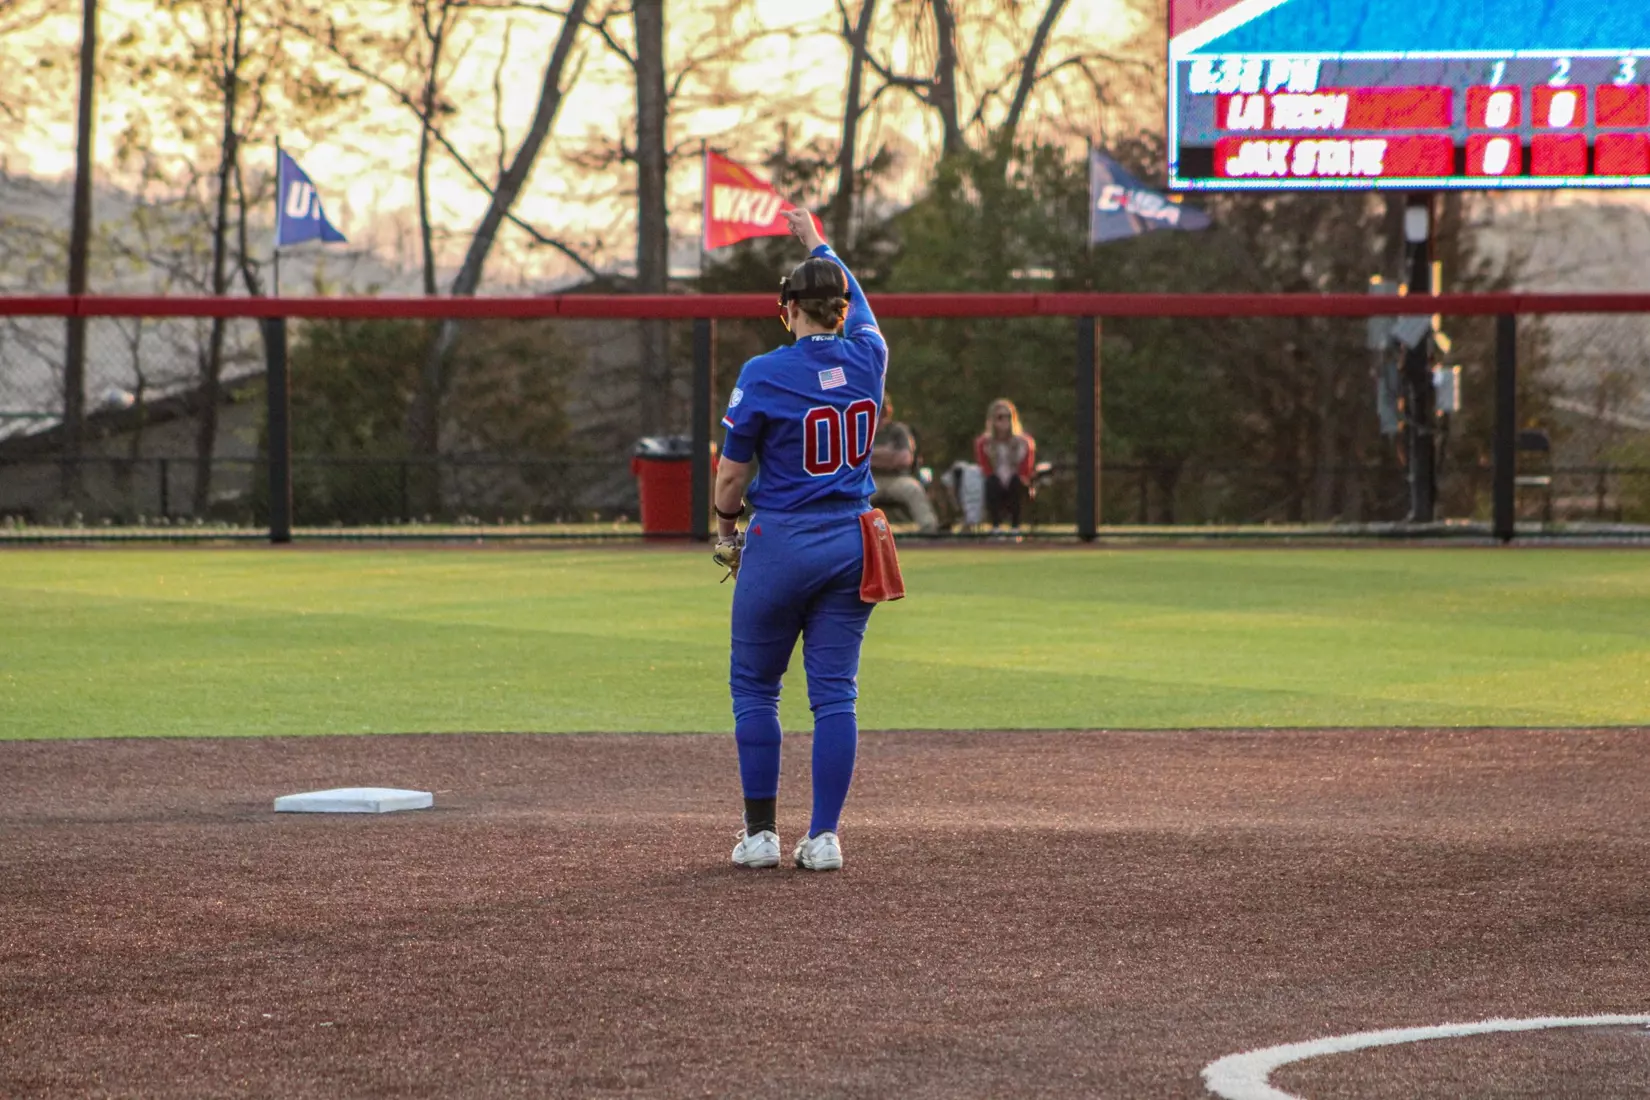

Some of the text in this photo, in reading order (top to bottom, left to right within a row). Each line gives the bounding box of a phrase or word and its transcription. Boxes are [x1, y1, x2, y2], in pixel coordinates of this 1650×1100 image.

[1490, 57, 1637, 88] 1 2 3
[1226, 94, 1265, 130] LA
[1484, 91, 1513, 128] 0
[1548, 91, 1577, 128] 0
[1482, 137, 1511, 175] 0
[712, 183, 782, 227] WKU
[803, 398, 878, 477] 00
